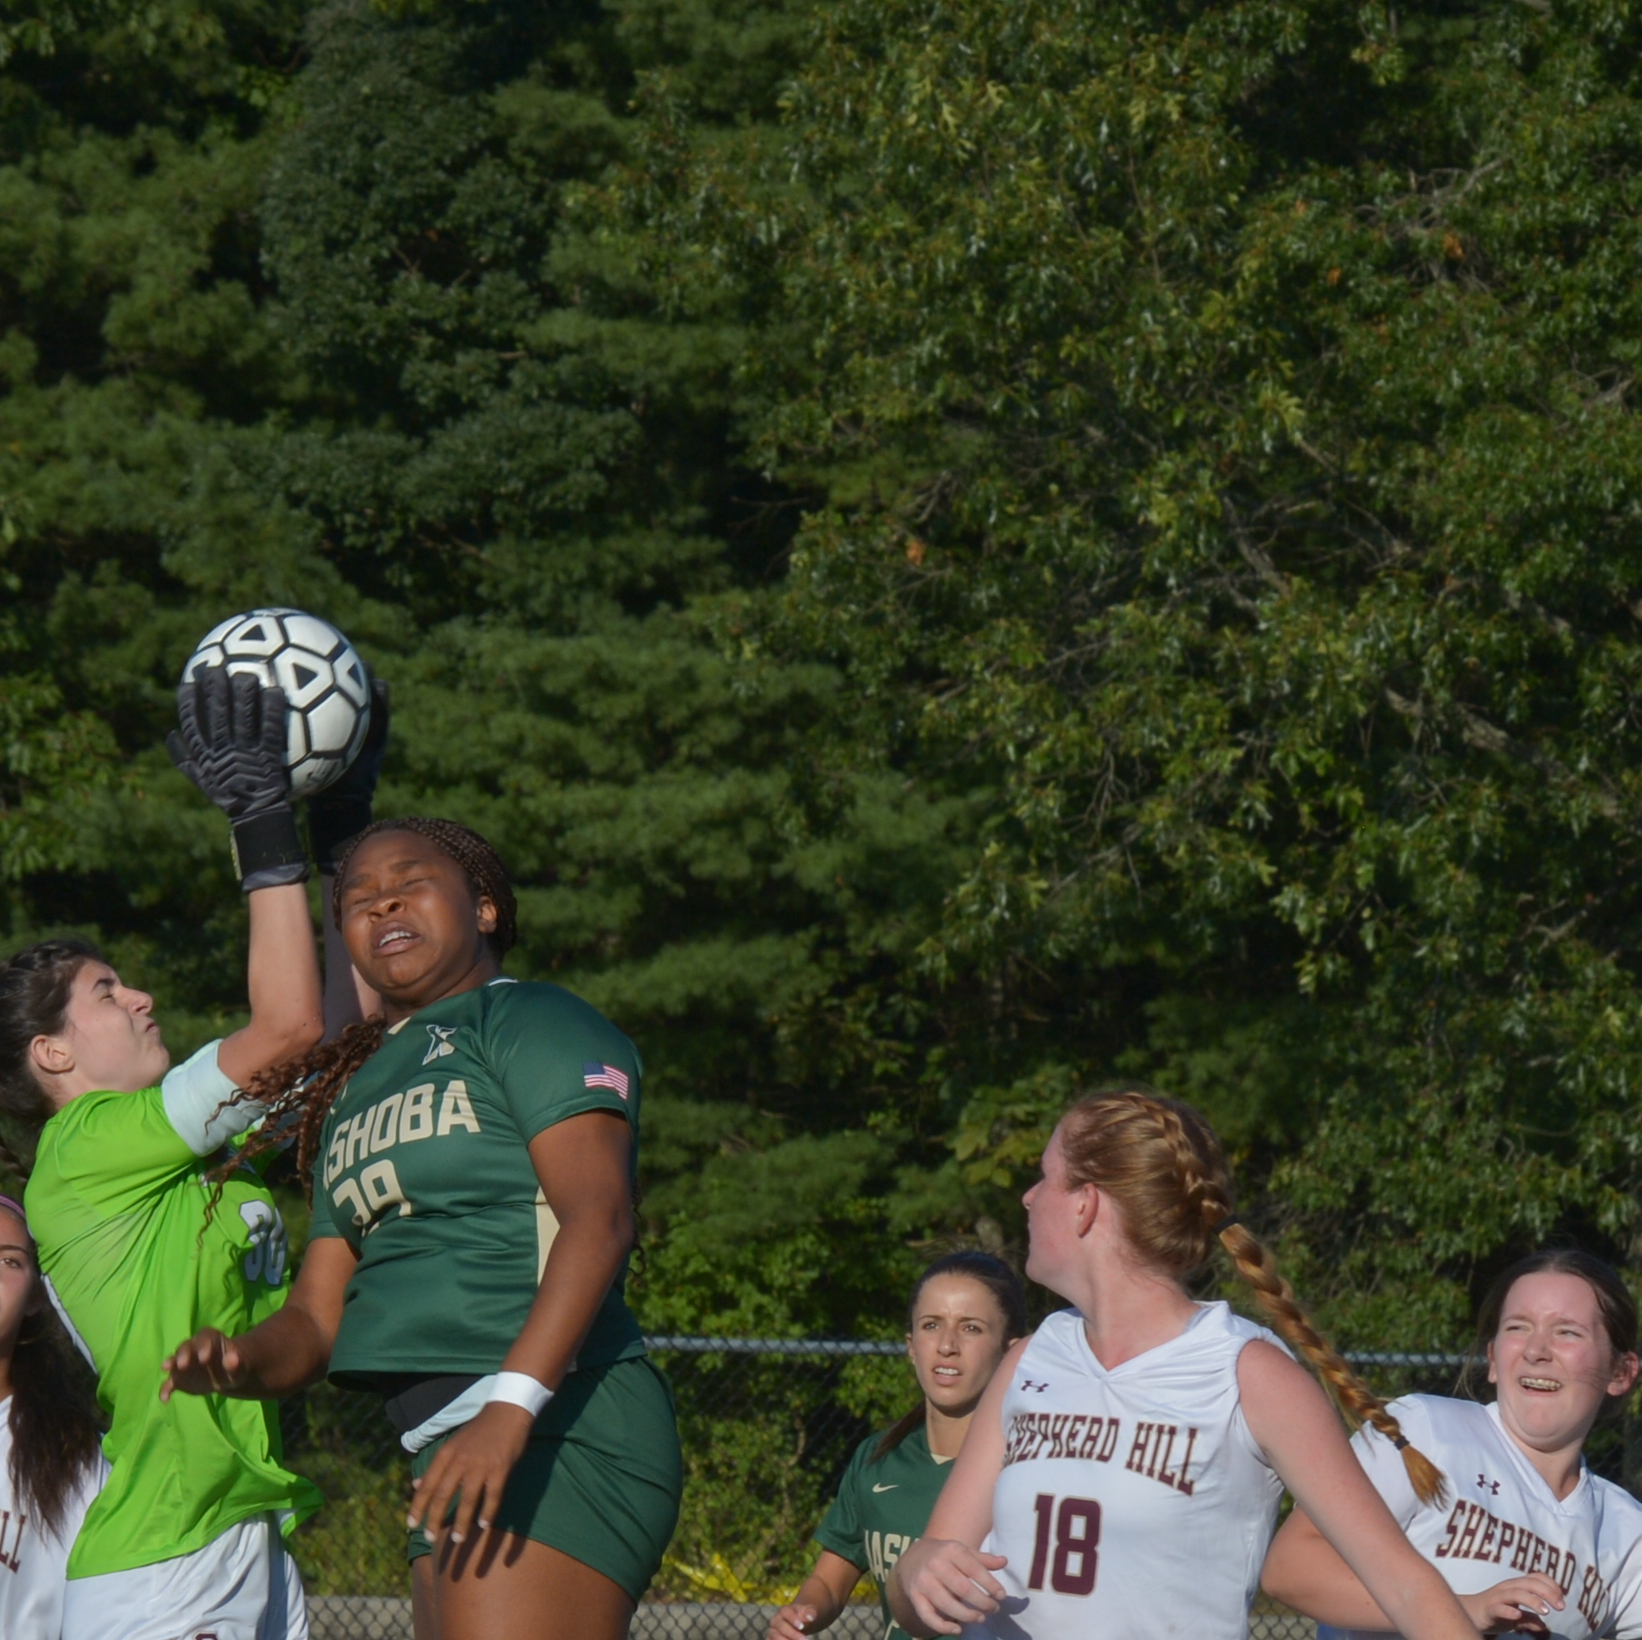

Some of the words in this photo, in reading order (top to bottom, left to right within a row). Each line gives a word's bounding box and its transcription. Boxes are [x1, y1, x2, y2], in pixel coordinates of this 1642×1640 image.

[323, 1079, 481, 1191] SHOBA
[1125, 1421, 1198, 1496] HILL
[1028, 1481, 1102, 1598] 18
[1435, 1498, 1577, 1596] SHEPHERD
